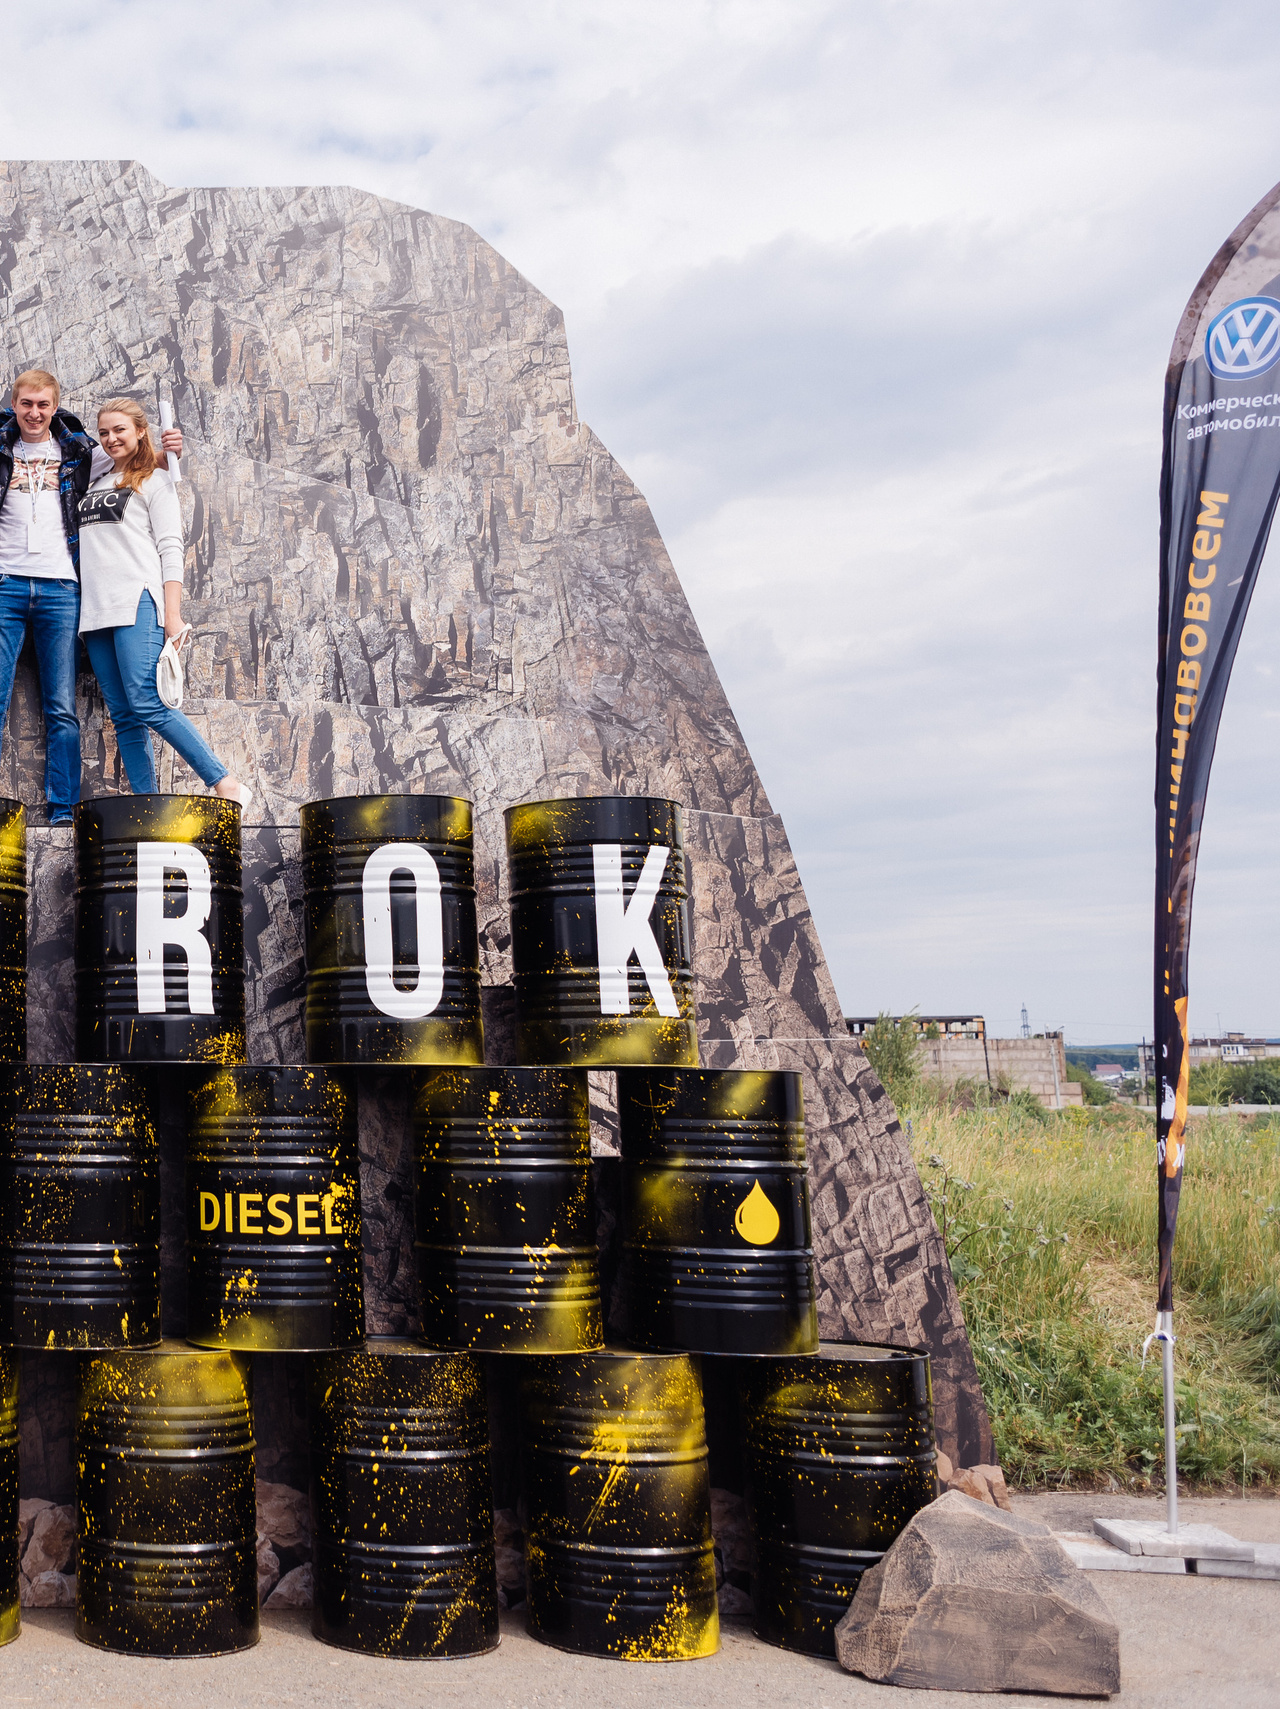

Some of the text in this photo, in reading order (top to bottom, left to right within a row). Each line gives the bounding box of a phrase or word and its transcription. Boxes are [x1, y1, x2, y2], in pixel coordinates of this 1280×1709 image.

[1177, 393, 1280, 420] Коммерческ
[1186, 413, 1280, 440] автомобил
[200, 1191, 343, 1236] DIESEL
